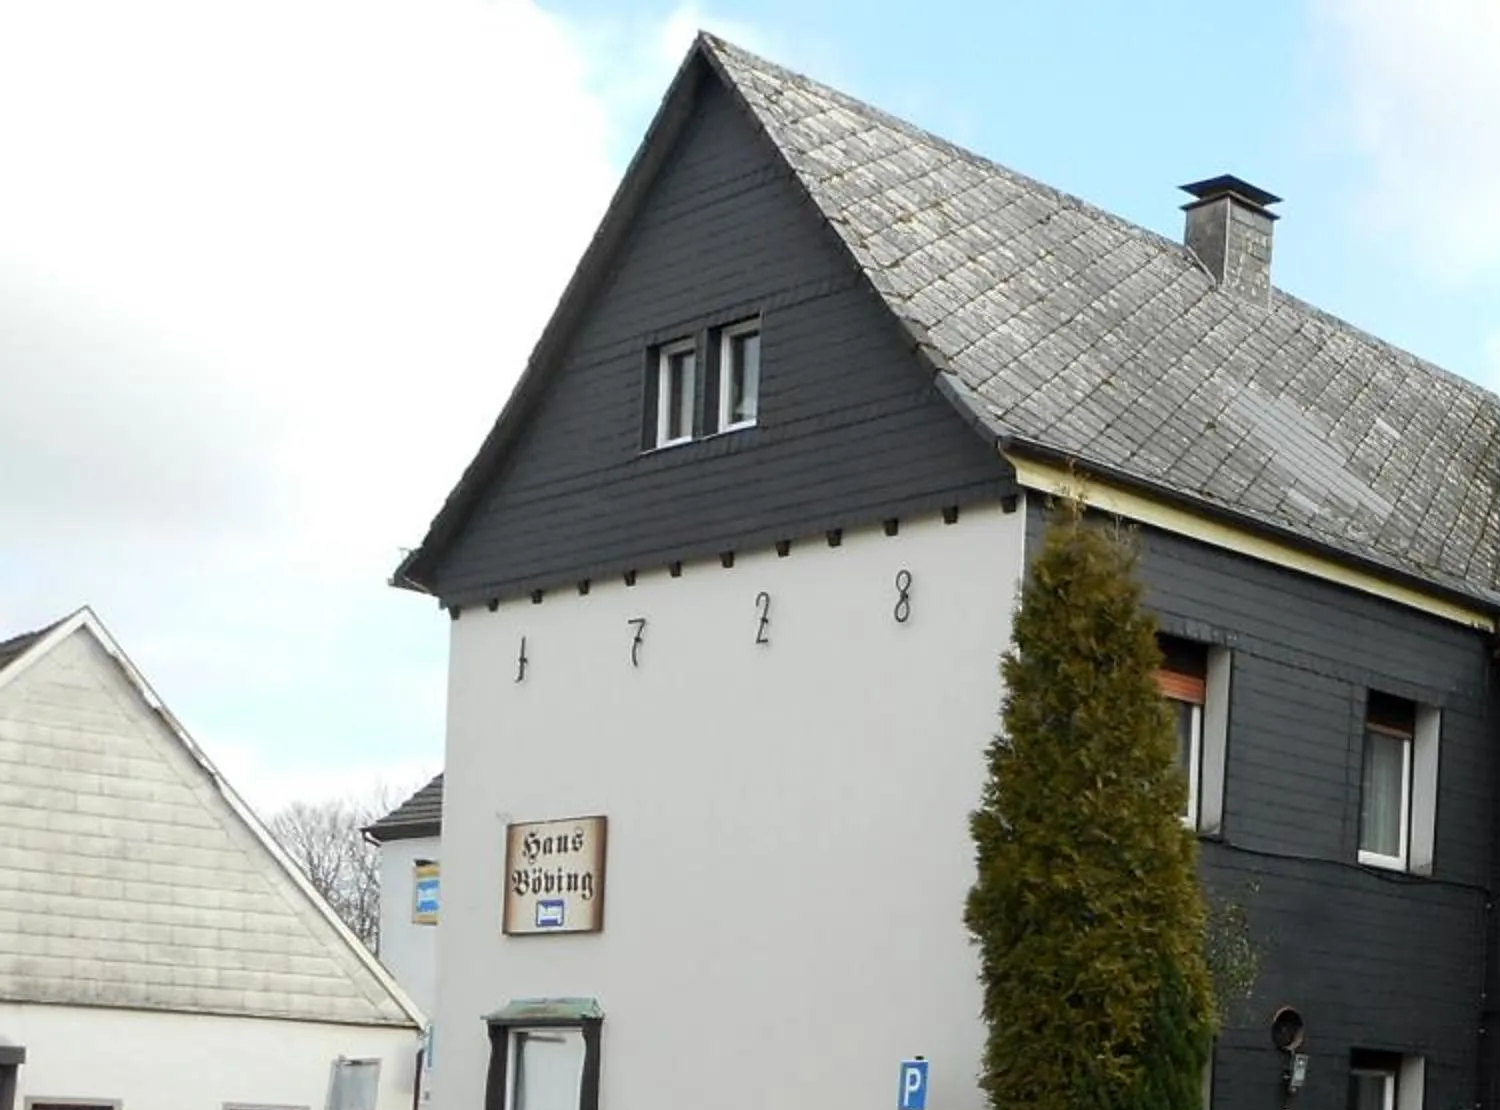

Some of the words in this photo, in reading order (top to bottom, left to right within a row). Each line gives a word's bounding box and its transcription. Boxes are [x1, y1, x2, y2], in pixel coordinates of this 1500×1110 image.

[522, 827, 584, 864] Haus
[511, 866, 593, 900] Böving
[903, 1067, 921, 1107] P
